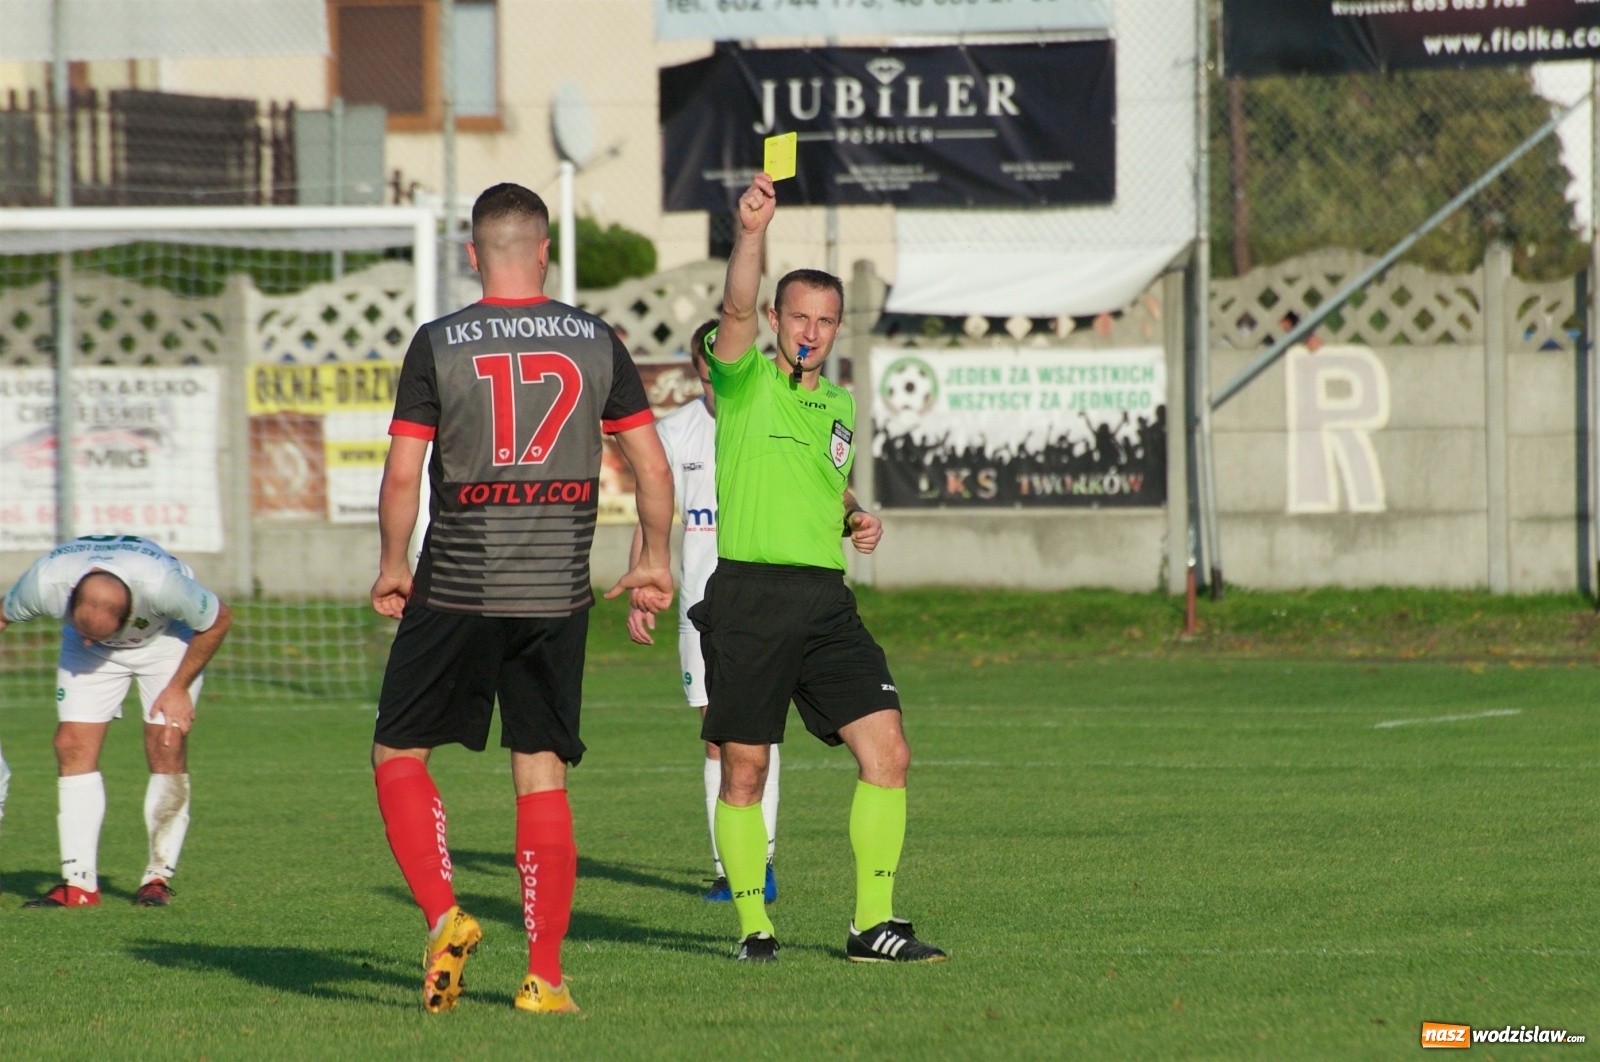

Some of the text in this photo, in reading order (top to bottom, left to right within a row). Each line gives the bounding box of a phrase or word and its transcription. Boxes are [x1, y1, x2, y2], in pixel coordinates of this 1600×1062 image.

[445, 314, 595, 345] LKS TWORKÓW
[945, 364, 1155, 386] JEDEN ZA WSZYSTKICH
[472, 351, 583, 467] 17
[946, 391, 1153, 411] WSZYSCY ZA JEDNEGO
[1285, 345, 1391, 513] R
[685, 672, 693, 685] 9
